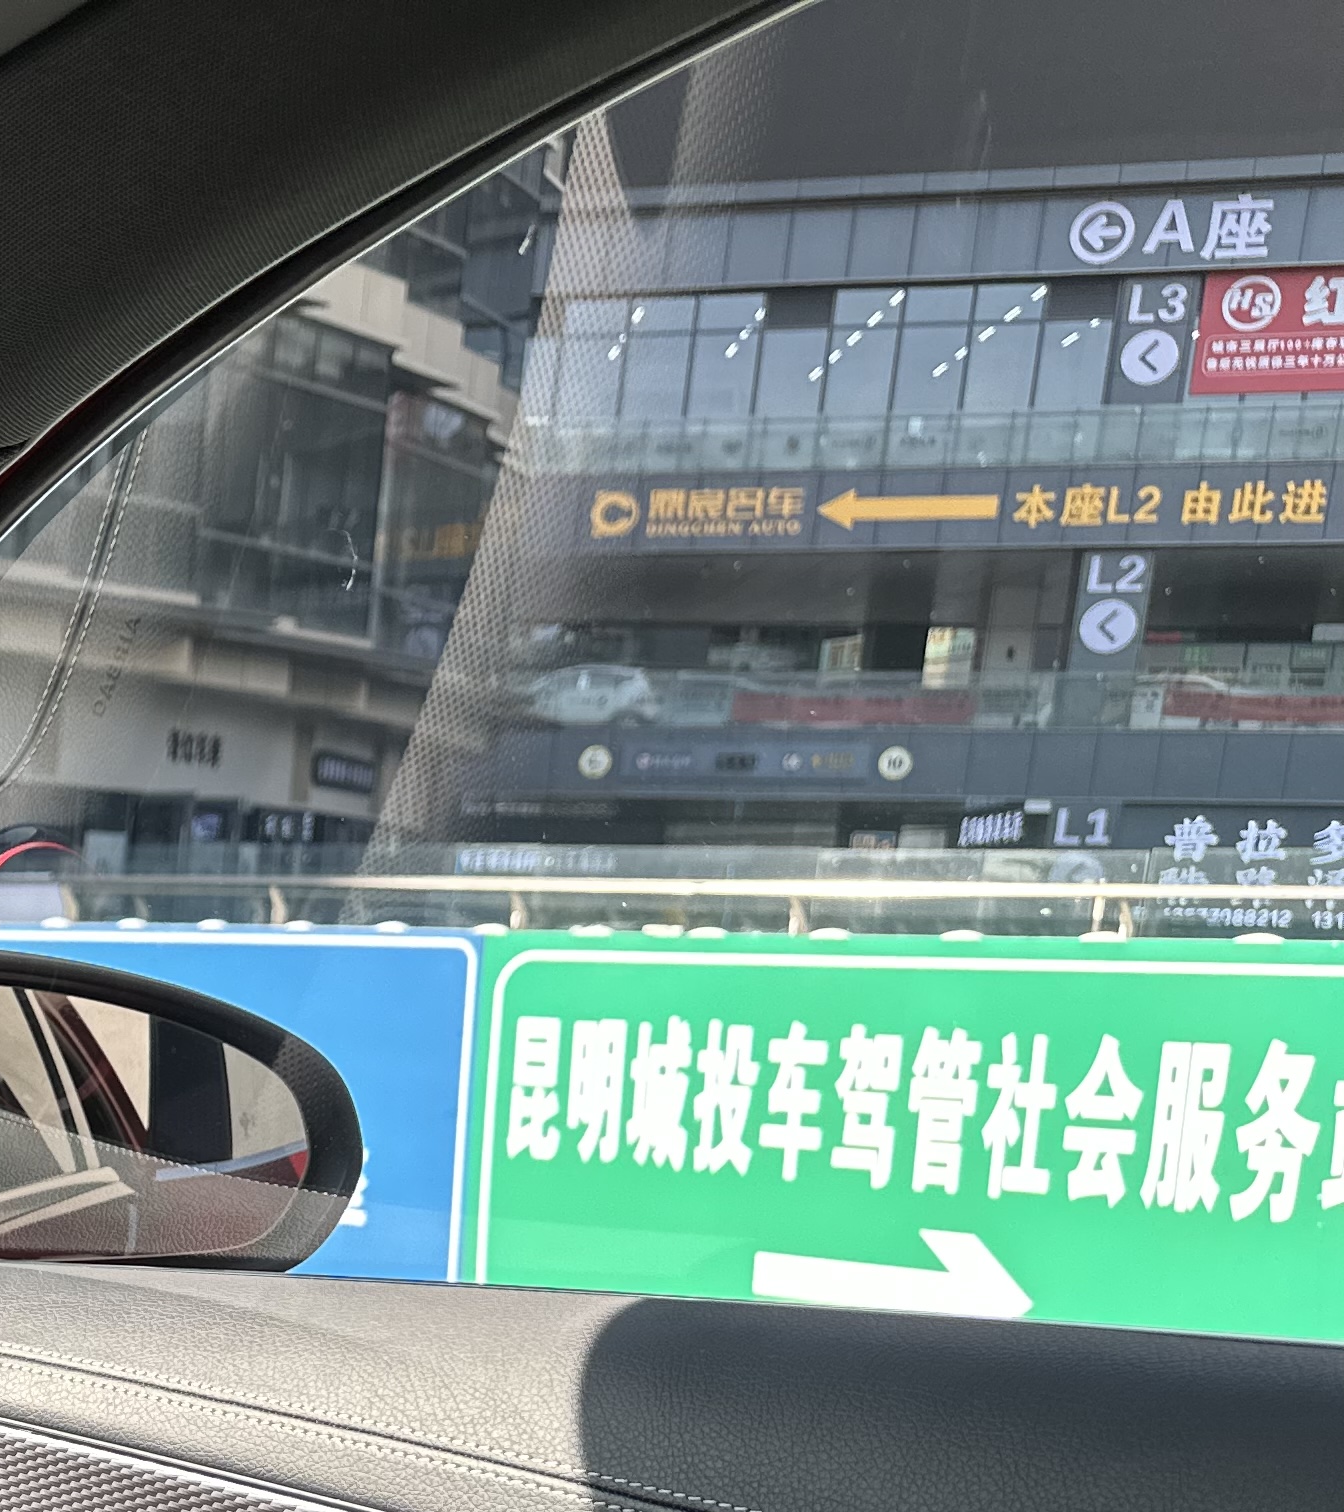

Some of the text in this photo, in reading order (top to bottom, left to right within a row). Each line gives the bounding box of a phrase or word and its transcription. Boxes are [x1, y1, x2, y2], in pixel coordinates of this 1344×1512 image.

[1142, 193, 1275, 259] A座
[1128, 282, 1187, 323] L3
[1013, 479, 1327, 528] 本座L2 由此进
[748, 518, 802, 536] AUTO
[1087, 554, 1146, 595] L2
[1053, 807, 1111, 847] L1
